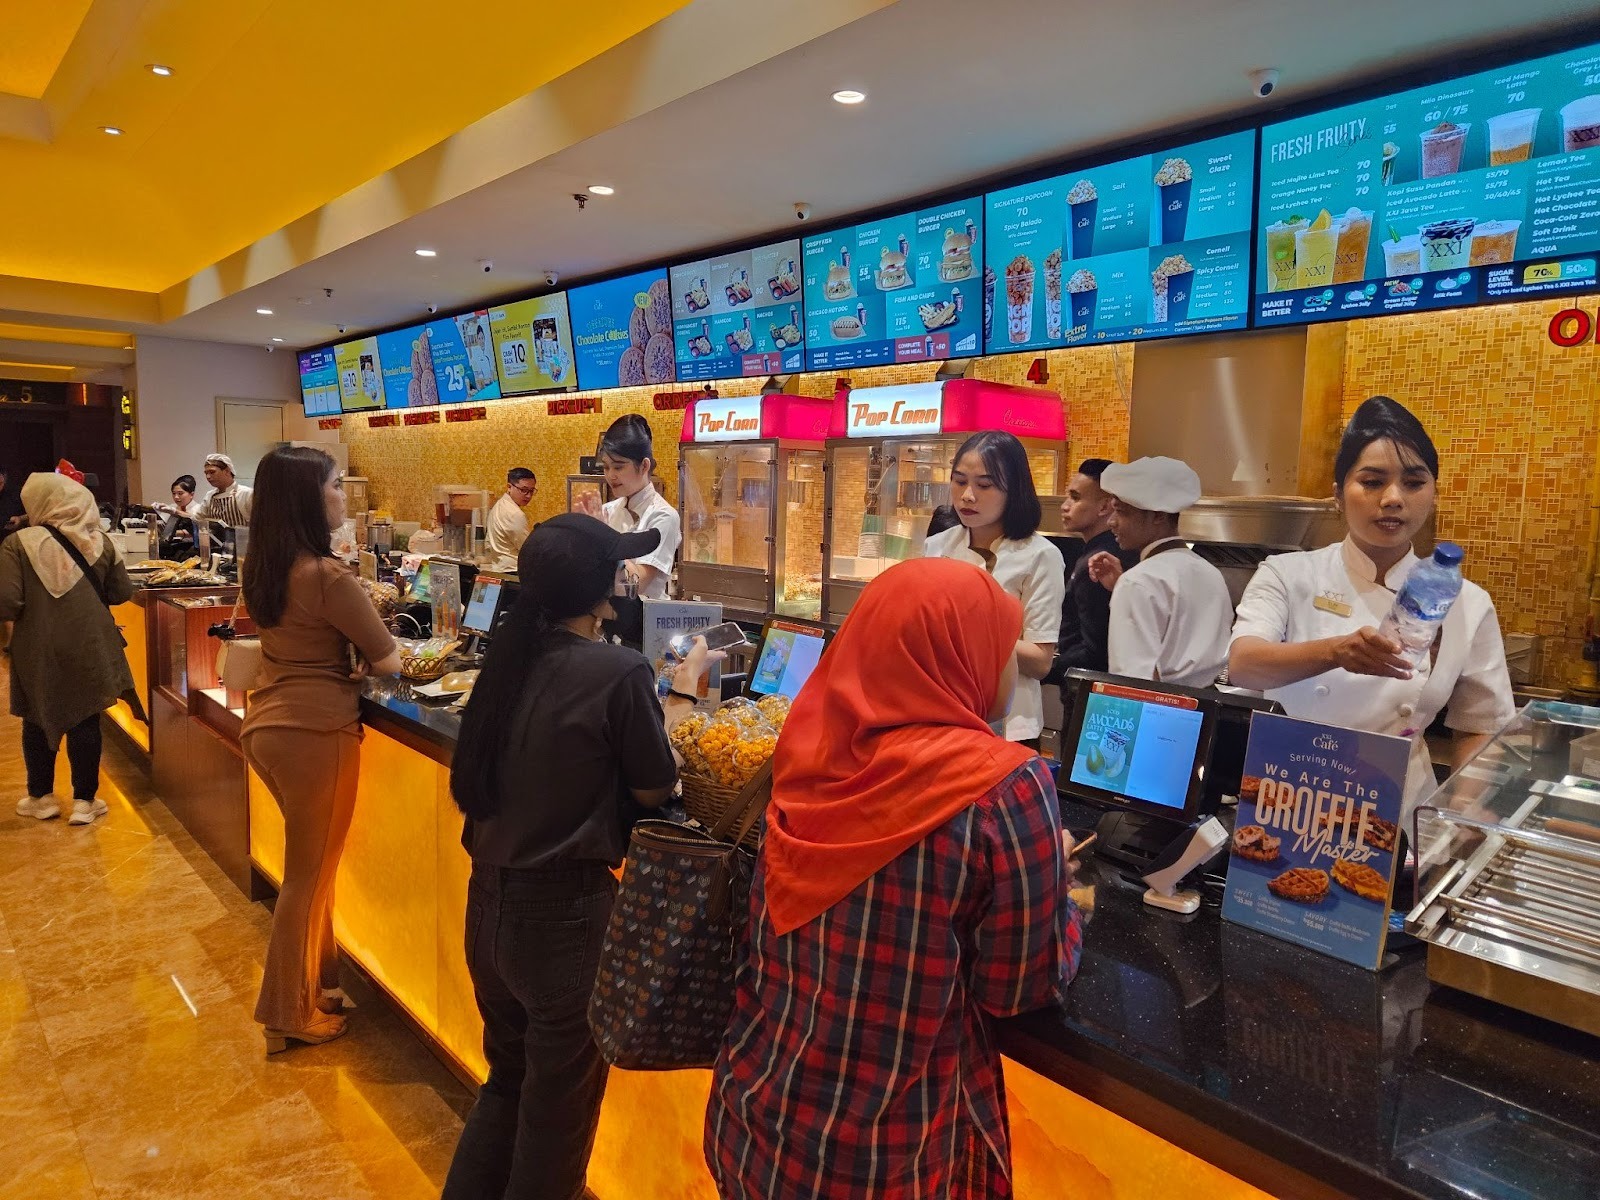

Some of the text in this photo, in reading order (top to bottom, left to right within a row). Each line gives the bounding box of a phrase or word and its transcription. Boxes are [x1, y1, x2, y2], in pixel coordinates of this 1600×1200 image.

[1494, 70, 1540, 86] Iced Mango
[1506, 80, 1527, 89] Latte
[1437, 89, 1474, 103] Dinosaurs
[1507, 91, 1525, 104] 70
[1424, 104, 1469, 122] 60 75
[1383, 123, 1397, 135] 55
[1270, 117, 1367, 163] FRESH FRUITY
[1207, 153, 1233, 165] Sweet
[1356, 159, 1371, 171] 70
[1536, 154, 1586, 168] Lemon Tea
[1208, 164, 1231, 174] Glaze
[1485, 169, 1510, 179] 55/70
[1271, 168, 1340, 187] Iced Mojito Lime Tea
[1356, 173, 1370, 184] 70
[1535, 174, 1571, 187] Hot Tea
[1111, 182, 1126, 192] Salt
[1199, 186, 1216, 194] Small
[1270, 182, 1333, 200] Orange Honey Tea
[1355, 185, 1370, 197] 70
[1386, 187, 1404, 197] Kopi
[1404, 184, 1424, 195] Susu
[1424, 179, 1456, 190] Pandan
[1484, 180, 1508, 190] 55/75
[994, 190, 1054, 209] SIGNATURE POPCORN
[1198, 193, 1221, 204] Medium
[1270, 196, 1323, 211] Iced Lychee Tea
[1386, 197, 1404, 207] Iced
[1404, 191, 1438, 204] Avocado
[1438, 188, 1460, 199] Latte
[1534, 190, 1584, 204] Hot Lychee
[1016, 207, 1028, 218] 70
[1168, 202, 1183, 212] Café
[1198, 203, 1215, 212] Large
[1399, 205, 1419, 216] Java
[1419, 203, 1435, 211] Tea
[1533, 200, 1597, 215] Hot Chocolate
[918, 208, 967, 226] DOUBLE CHICKEN
[1532, 210, 1600, 226] Coca-Cola Zero
[918, 223, 941, 234] BURGER
[1003, 217, 1042, 232] Spicy Balado
[1101, 223, 1117, 231] Large
[1532, 224, 1578, 237] Soft Drink
[859, 228, 881, 240] CHICKEN
[806, 239, 822, 250] CRISPY
[859, 237, 879, 248] BURGER
[1429, 240, 1463, 258] XXI
[806, 247, 825, 257] BURGER
[1531, 244, 1558, 255] AQUA
[918, 256, 930, 265] 70
[1112, 272, 1124, 280] Mix
[1196, 266, 1215, 277] Spicy
[1488, 269, 1514, 278] SUGAR
[1487, 281, 1513, 289] OPTION
[1488, 276, 1512, 284] LEVEL
[1445, 290, 1463, 298] Foam
[1522, 284, 1543, 294] Lychee
[1570, 281, 1584, 289] Java
[894, 291, 935, 304] FISH AND CHIPS
[1195, 291, 1218, 299] Medium
[1262, 298, 1294, 309] MAKE IT
[1100, 313, 1115, 321] Large
[1261, 307, 1292, 317] BETTER
[1064, 323, 1087, 338] Extra
[1548, 307, 1600, 348] O
[576, 332, 605, 346] Chocolate
[1066, 332, 1088, 344] Flavor
[897, 341, 921, 350] COMPLETE
[897, 348, 911, 356] YOUR
[511, 343, 526, 364] 10
[1027, 358, 1049, 384] 4
[445, 364, 465, 392] 25
[20, 386, 33, 404] 5
[547, 400, 571, 415] PICK
[656, 615, 711, 629] FRESH FRUITY
[1155, 695, 1180, 705] GRATIS!
[1312, 738, 1339, 753] Café
[1289, 752, 1357, 776] Serving Now!
[1265, 763, 1380, 800] We Are The
[1254, 777, 1378, 852] CROFFLE
[1292, 827, 1380, 865] Master
[1304, 910, 1328, 924] SAVORY
